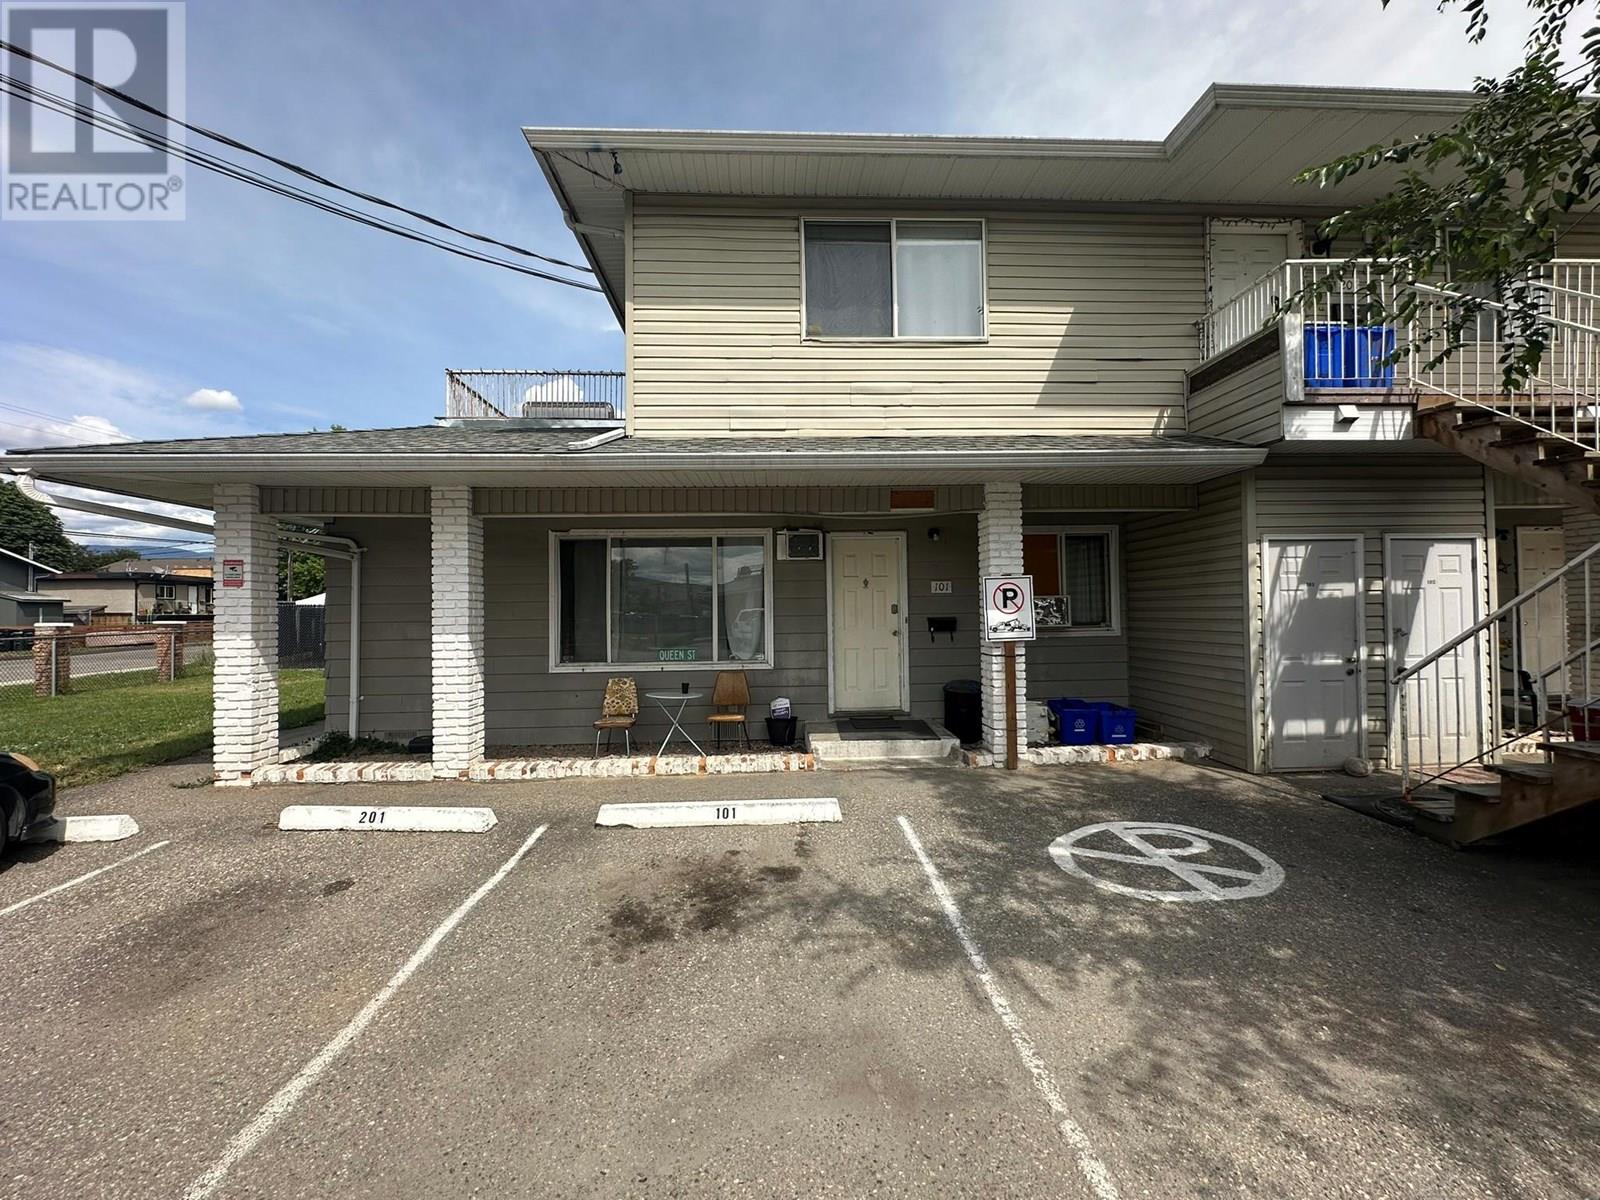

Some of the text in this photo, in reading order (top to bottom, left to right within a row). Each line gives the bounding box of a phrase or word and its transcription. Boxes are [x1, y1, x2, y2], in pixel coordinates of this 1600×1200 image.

[934, 582, 950, 592] 101
[1002, 588, 1018, 609] P
[659, 649, 696, 661] QUEEN ST
[358, 811, 386, 824] 201
[715, 807, 737, 820] 101
